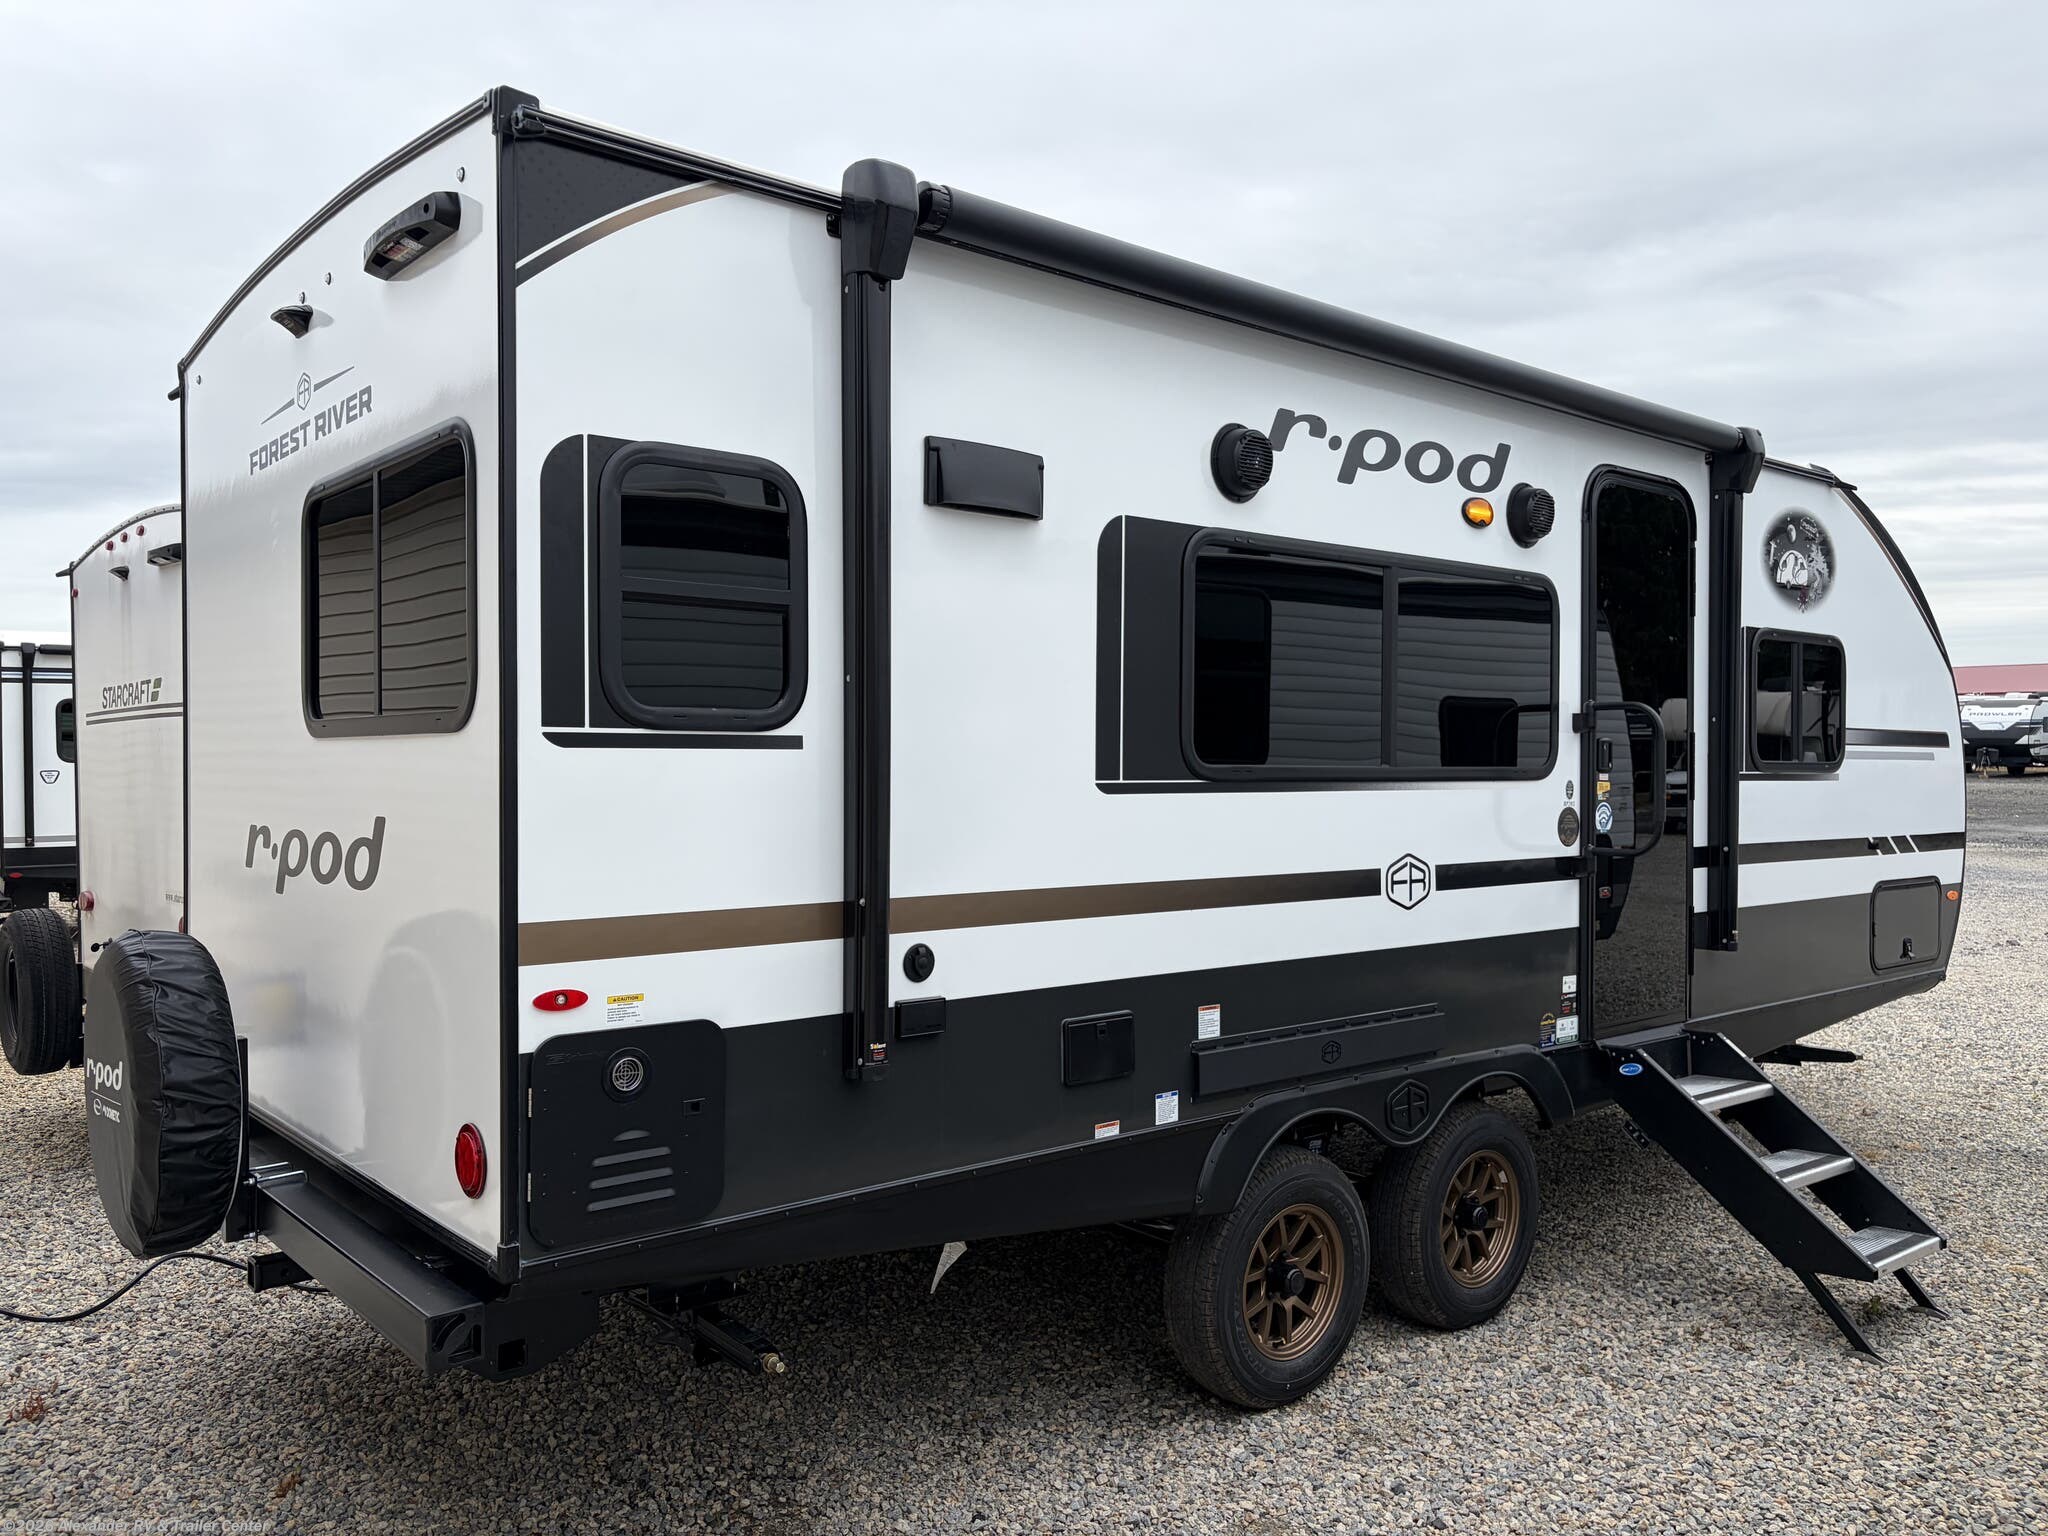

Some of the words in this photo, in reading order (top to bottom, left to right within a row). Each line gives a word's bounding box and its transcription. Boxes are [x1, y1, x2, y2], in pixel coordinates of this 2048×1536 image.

[249, 418, 311, 476] FOREST
[314, 384, 372, 441] RIVER
[102, 679, 151, 709] STARCRAFT
